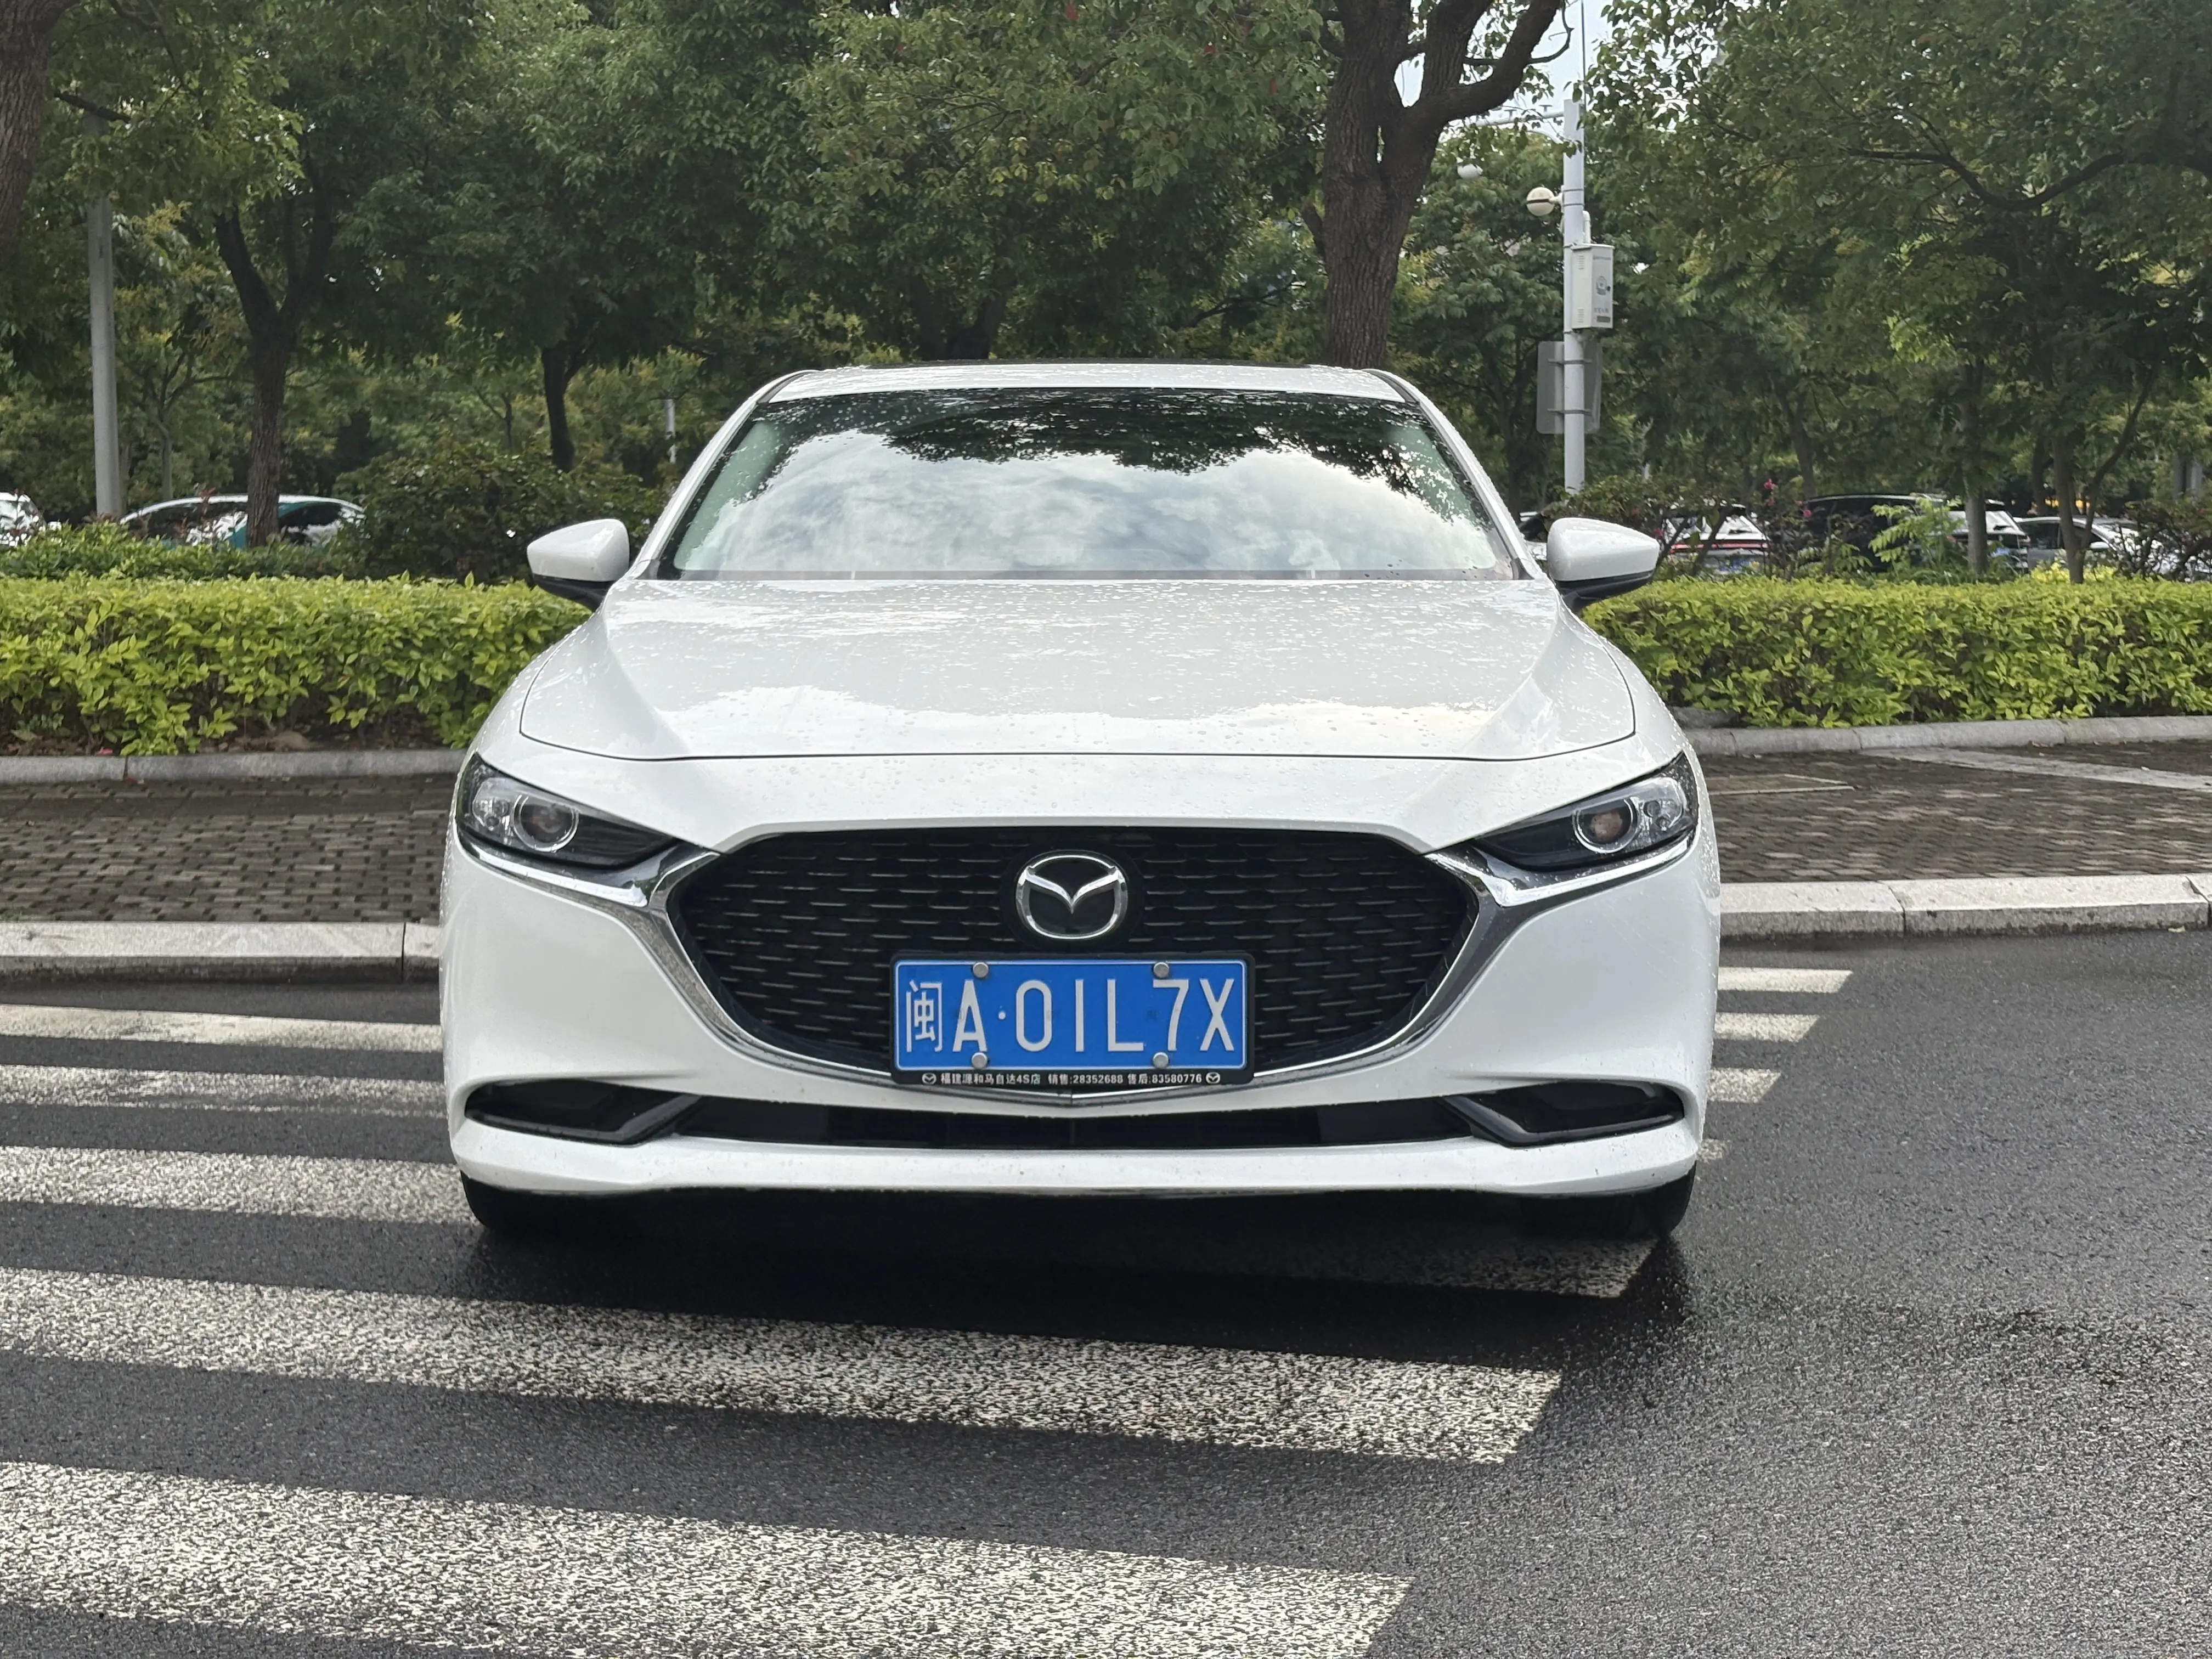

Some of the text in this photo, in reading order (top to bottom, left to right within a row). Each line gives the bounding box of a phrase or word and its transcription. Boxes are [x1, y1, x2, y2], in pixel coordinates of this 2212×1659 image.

[940, 1073, 1041, 1085] 福建源和马自达4S店
